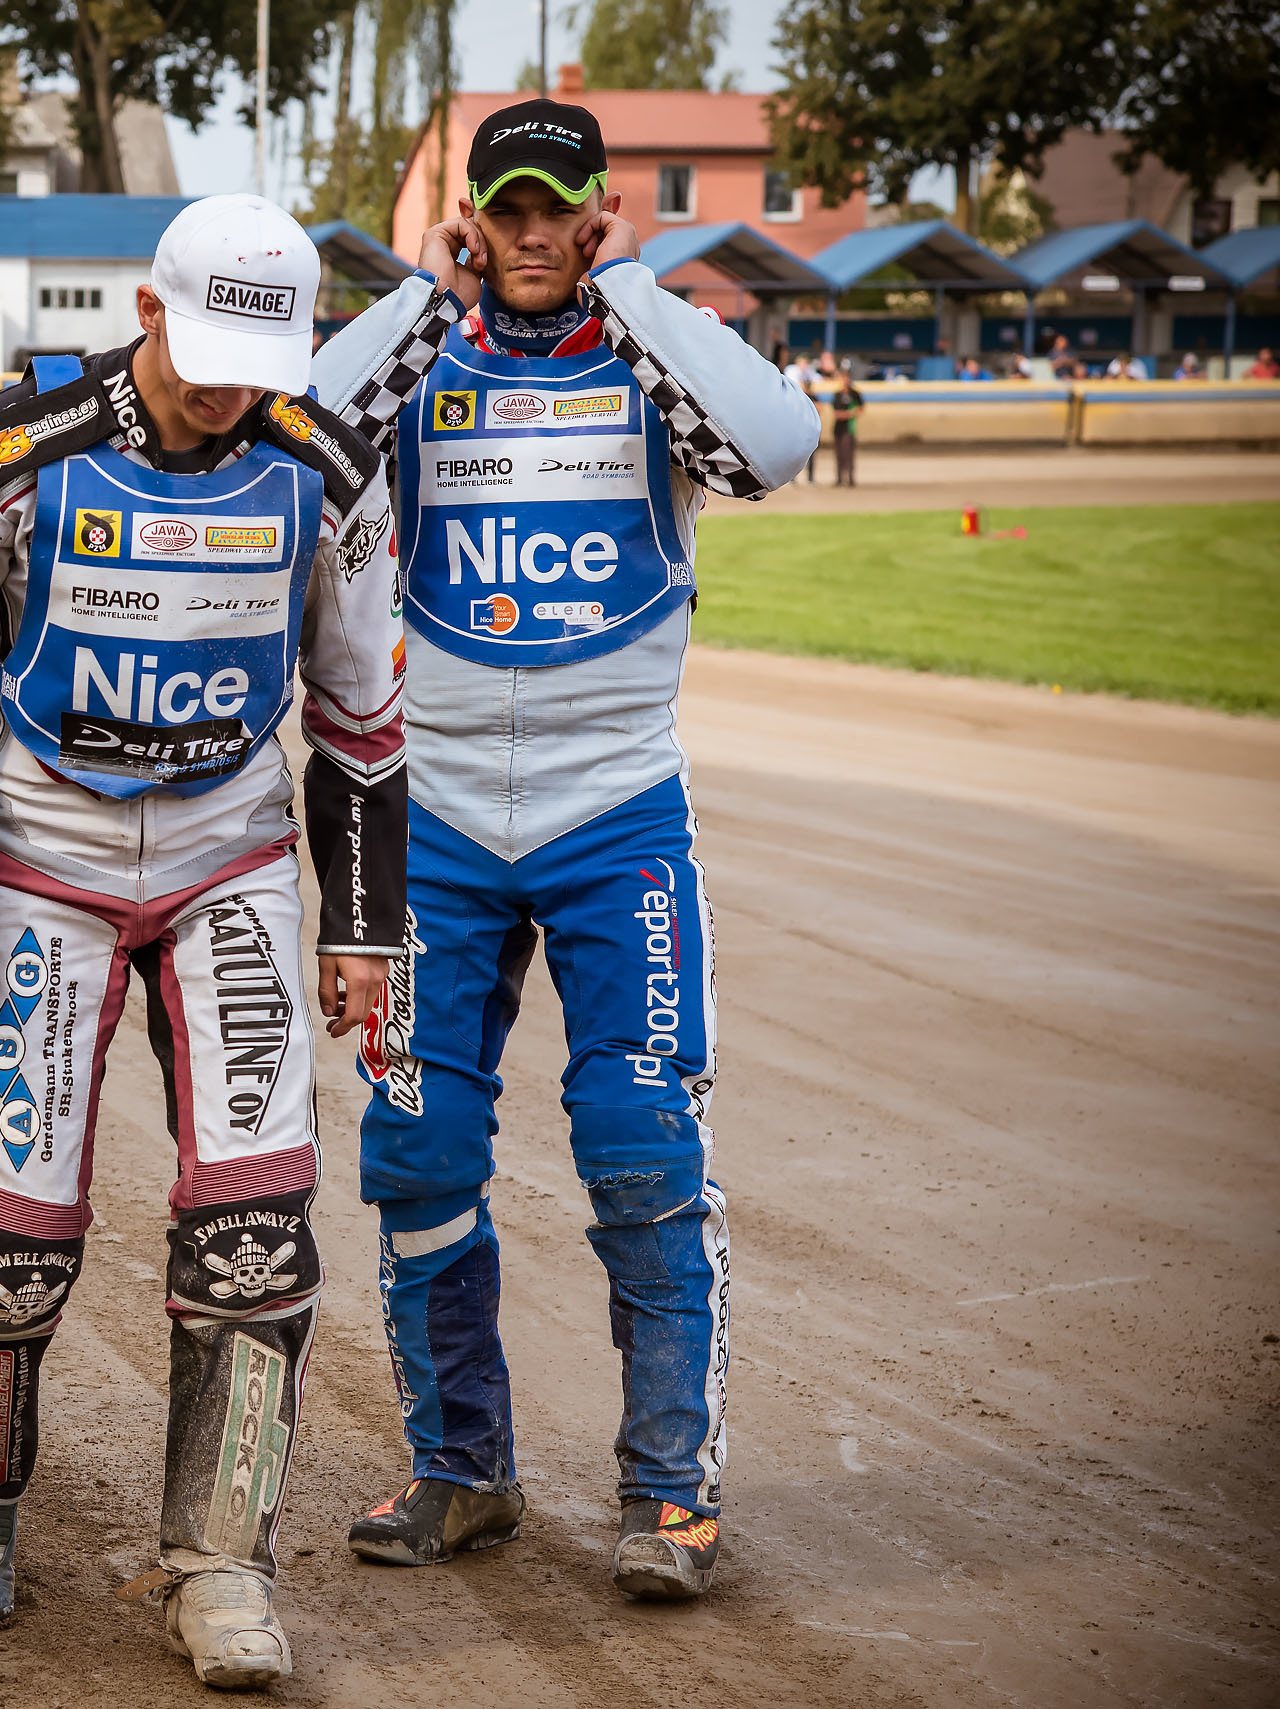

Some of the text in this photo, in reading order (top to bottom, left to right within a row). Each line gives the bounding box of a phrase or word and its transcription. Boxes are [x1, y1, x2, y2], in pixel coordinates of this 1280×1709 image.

[489, 121, 582, 146] Deli Tire
[549, 134, 581, 149] SYMBIOSIS
[212, 284, 289, 314] SAVAGE.
[103, 370, 146, 449] Nice
[503, 398, 535, 408] JAWA
[436, 458, 513, 478] FIBARO
[537, 459, 634, 472] Deli Tire
[437, 478, 513, 488] HOME INTELLIGENCE
[151, 525, 186, 536] JAWA
[88, 543, 107, 552] PZM
[445, 516, 619, 584] Nice
[72, 586, 160, 611] FIBARO
[185, 596, 280, 611] Deli Tire
[536, 605, 601, 616] elero
[71, 607, 159, 622] HOME INTELLIGENCE
[72, 646, 250, 723] Nice
[72, 722, 245, 760] Deli Tire
[188, 753, 241, 773] SYMBIOSIS
[347, 793, 368, 941] kw-products
[40, 936, 63, 1163] Gerdemann TRANSPORTE
[227, 1092, 264, 1133] OY
[194, 1211, 302, 1246] SMELLAWAYZ
[16, 1346, 30, 1389] pistons
[237, 1348, 267, 1475] ROCK
